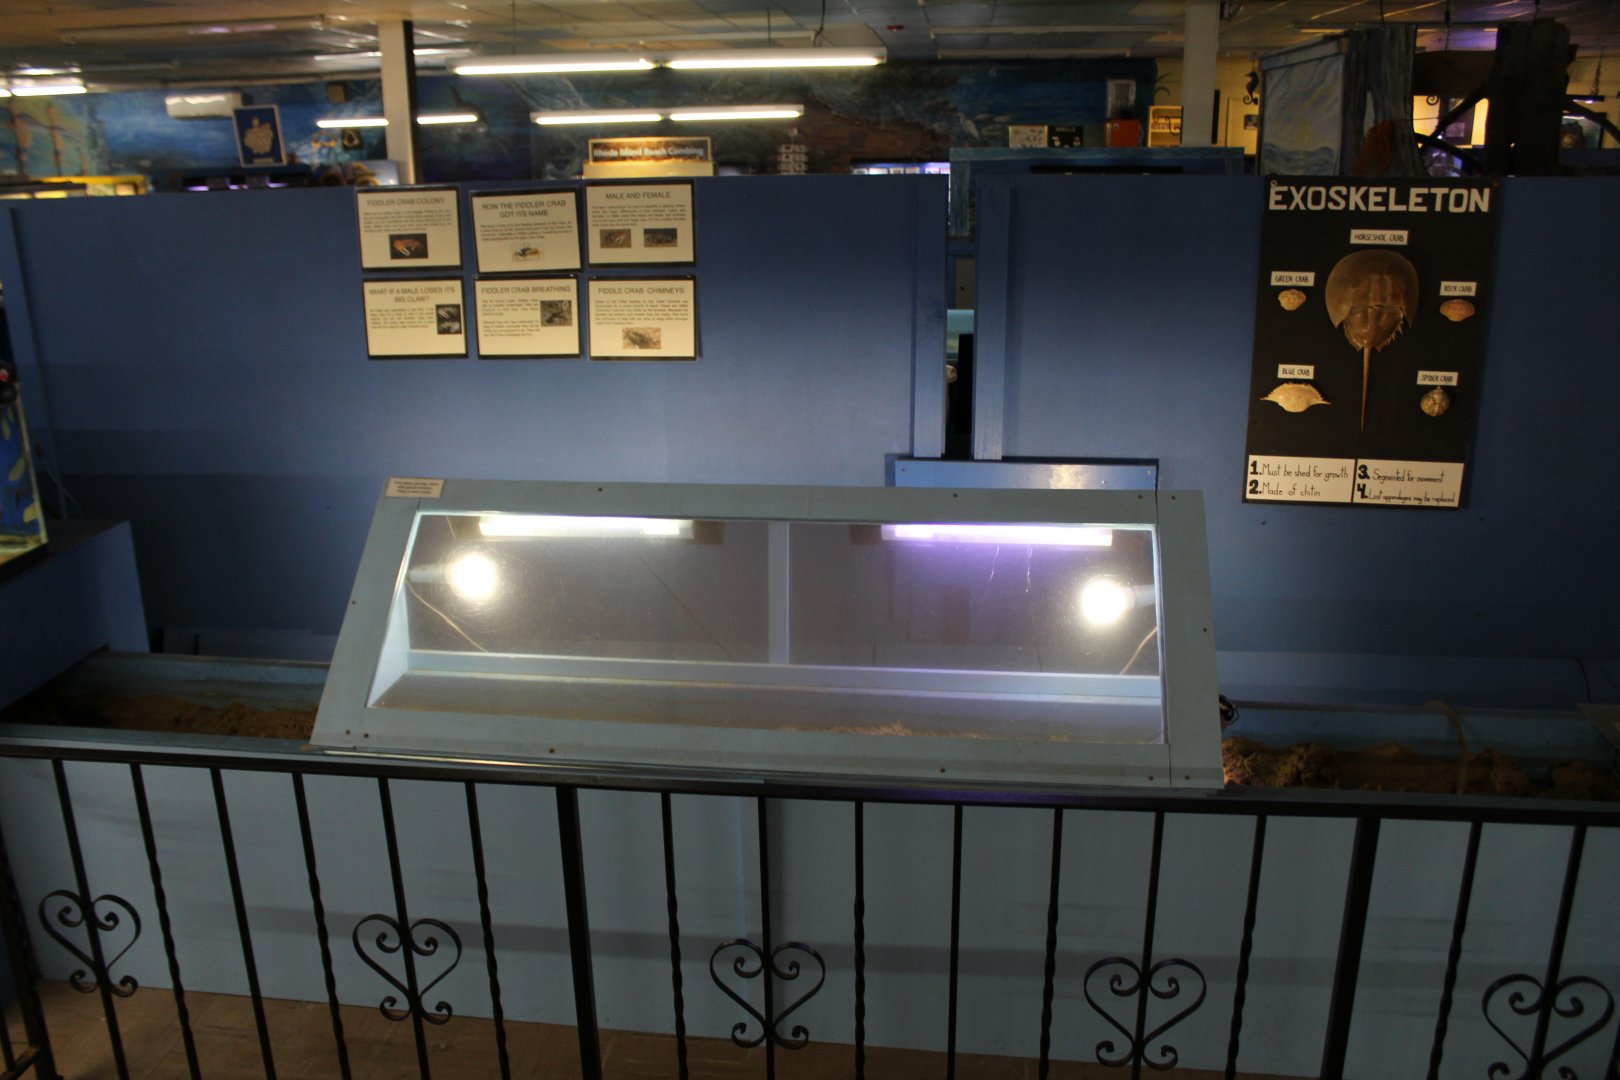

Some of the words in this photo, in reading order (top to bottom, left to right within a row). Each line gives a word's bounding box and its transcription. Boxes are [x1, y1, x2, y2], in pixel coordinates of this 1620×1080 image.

[593, 147, 619, 158] Rhode
[619, 147, 642, 157] Island
[643, 146, 667, 156] Beach
[605, 192, 625, 200] MALE
[642, 191, 671, 199] FEMALE
[1268, 185, 1490, 213] EXOSKELETON
[367, 198, 396, 207] FIDDLER
[396, 198, 415, 206] CRAB
[416, 197, 445, 205] COLONY
[482, 202, 499, 210] HOW
[515, 201, 545, 209] FIDDLER
[528, 209, 549, 217] NAME
[1354, 233, 1387, 242] HORSESHOE
[1389, 234, 1405, 242] CRAB
[1274, 275, 1293, 283] GREEN
[1294, 275, 1309, 283] CRAB
[531, 285, 571, 293] BREATHING
[1444, 285, 1457, 293] ROCK
[1458, 285, 1473, 293] CRAB
[1281, 367, 1295, 375] BLUE
[1296, 368, 1311, 376] CRAB
[1420, 374, 1439, 382] SPIDER
[1262, 463, 1281, 477] Must
[1283, 464, 1292, 477] be
[1294, 464, 1311, 478] shed
[1313, 465, 1322, 478] for
[1324, 465, 1349, 482] growth
[1373, 467, 1405, 484] Segmented
[1407, 469, 1415, 482] for
[1417, 469, 1445, 483] movement
[1262, 482, 1283, 496] Made
[1288, 483, 1297, 496] of
[1300, 484, 1321, 497] chitin
[1368, 488, 1383, 500] Lost
[1413, 496, 1423, 504] may
[1424, 491, 1431, 502] be
